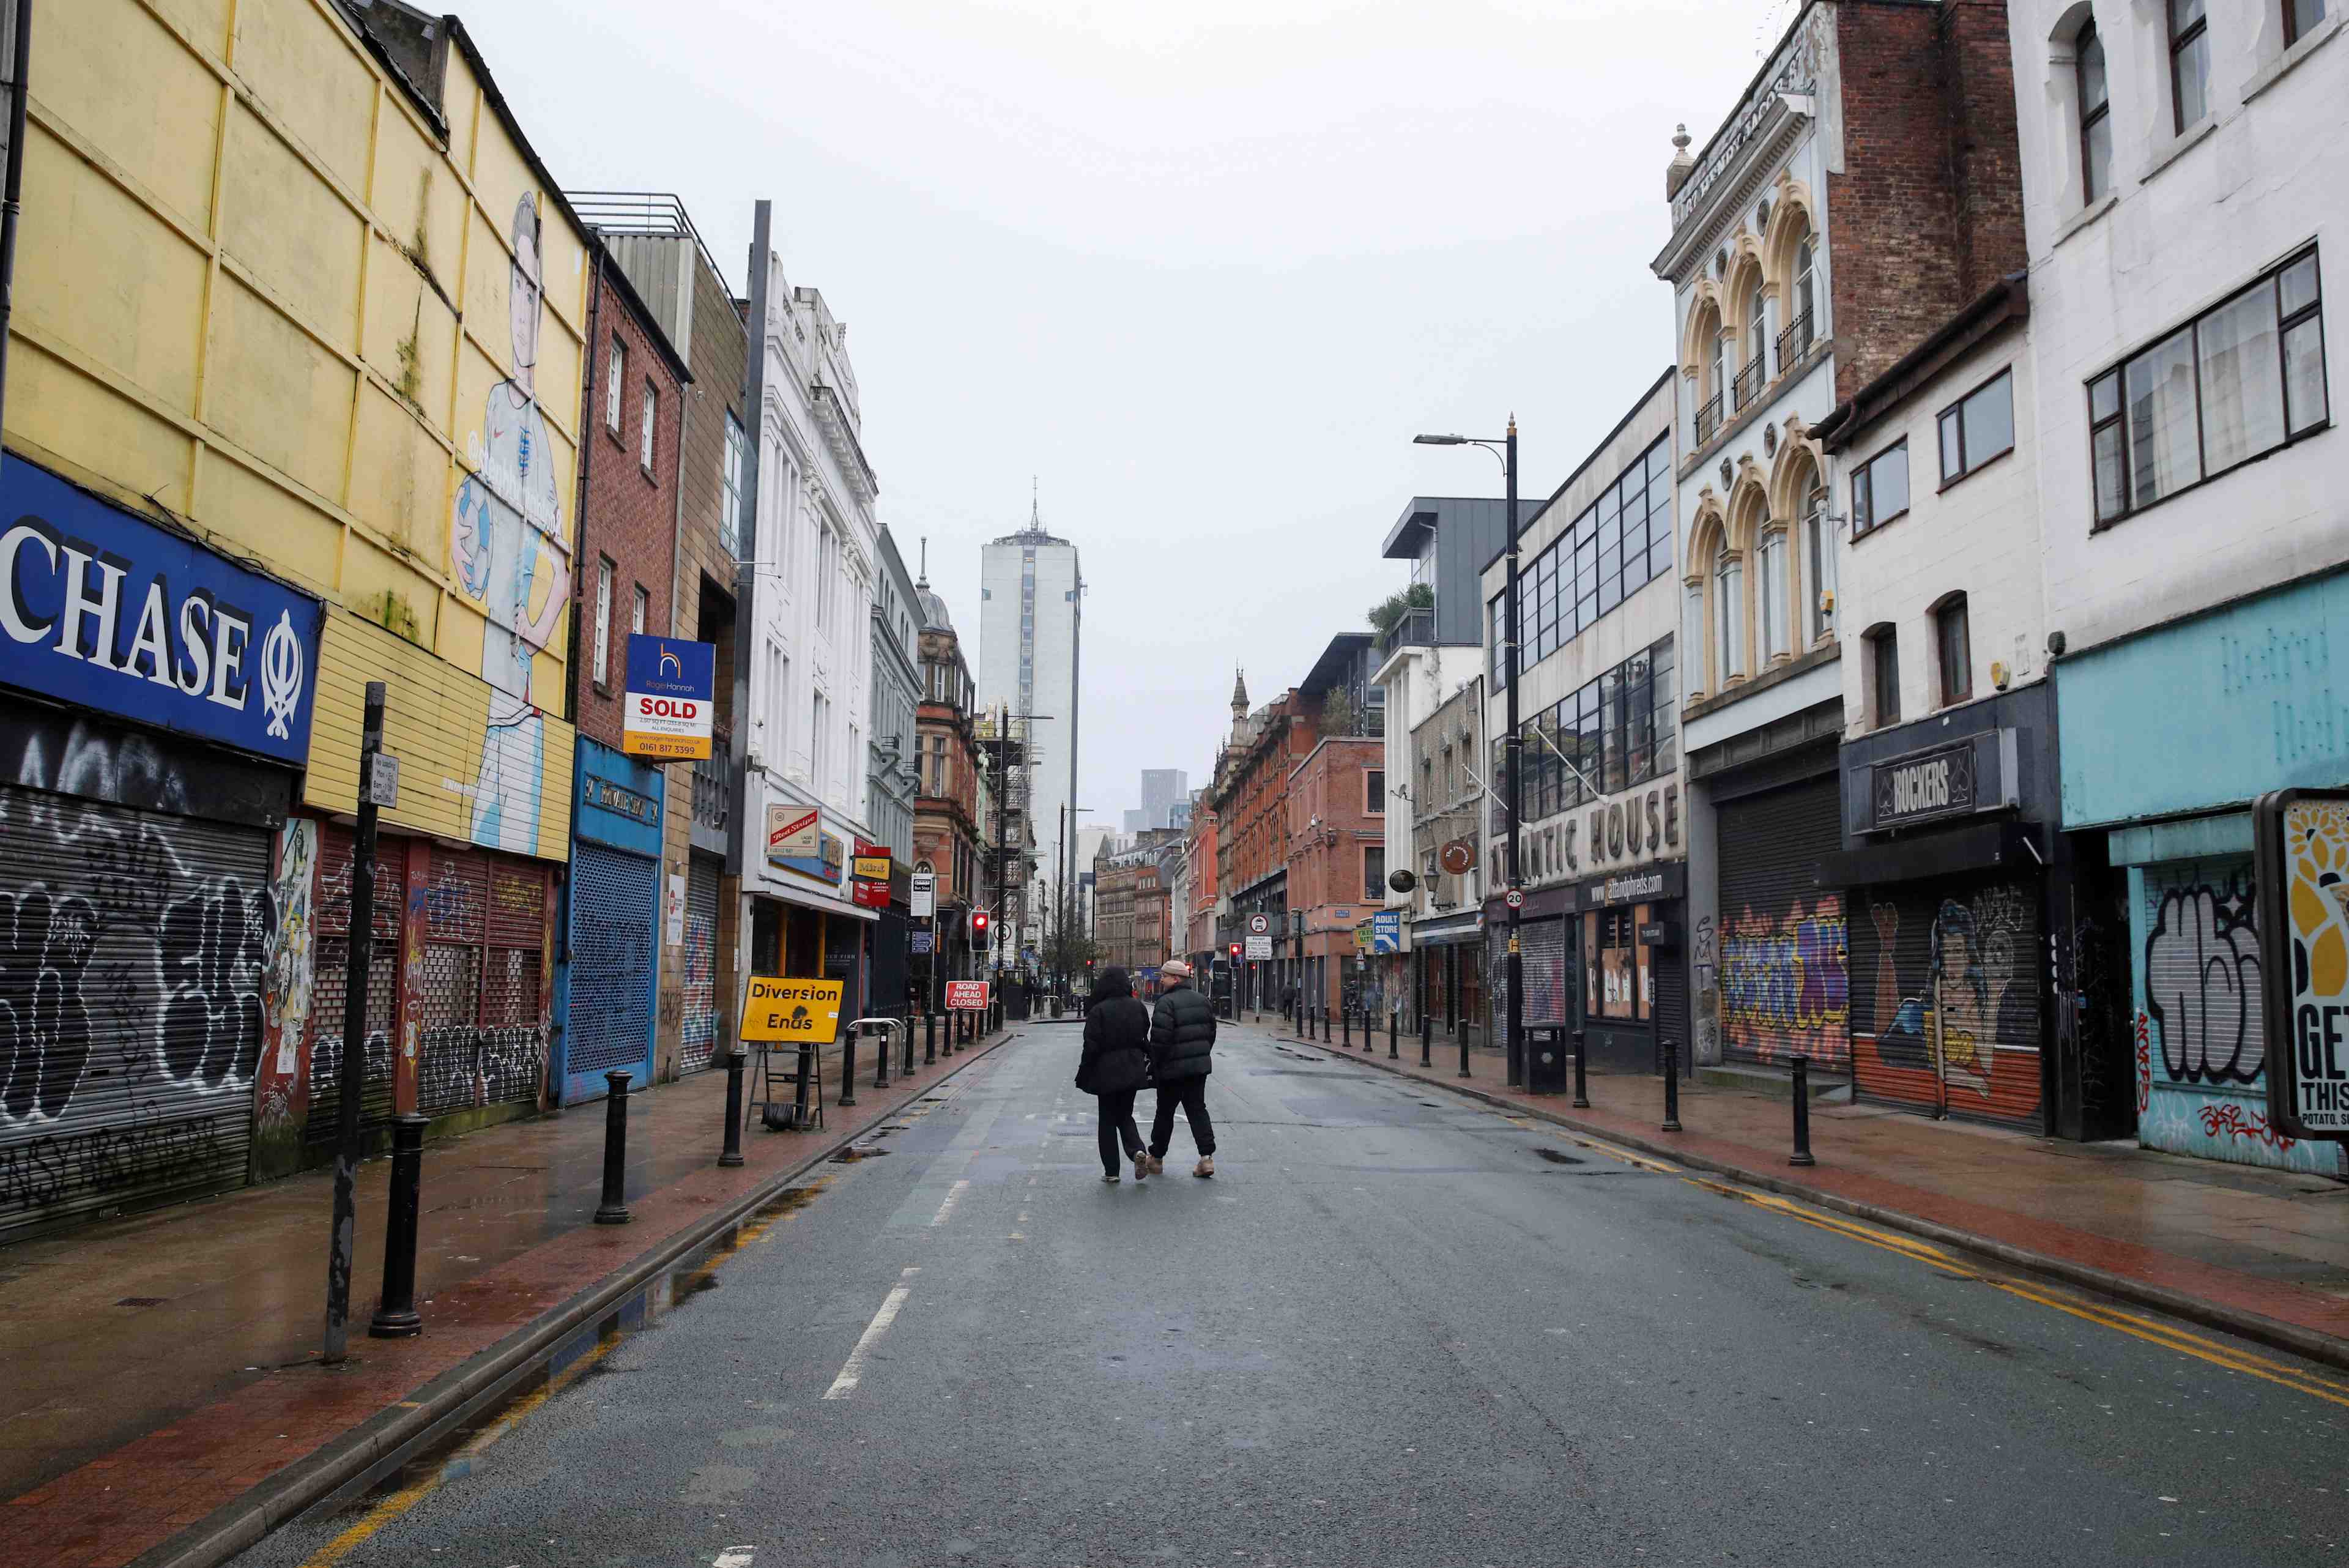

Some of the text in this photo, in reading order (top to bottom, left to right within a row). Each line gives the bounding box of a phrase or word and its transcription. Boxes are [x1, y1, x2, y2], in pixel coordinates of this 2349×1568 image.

[0, 524, 251, 712] CHASE
[639, 697, 697, 719] SOLD
[639, 742, 696, 754] 0161 817 3399
[1893, 759, 1949, 814] ROCKERS
[773, 816, 815, 842] Red Stripe
[1491, 782, 1679, 889] ATANTIC HOUSE
[1508, 894, 1522, 903] 20
[1375, 925, 1398, 934] STORE
[1511, 940, 1520, 951] H
[751, 983, 838, 1001] Diversion
[767, 1013, 813, 1030] Ends
[2302, 1113, 2338, 1126] POTATO,
